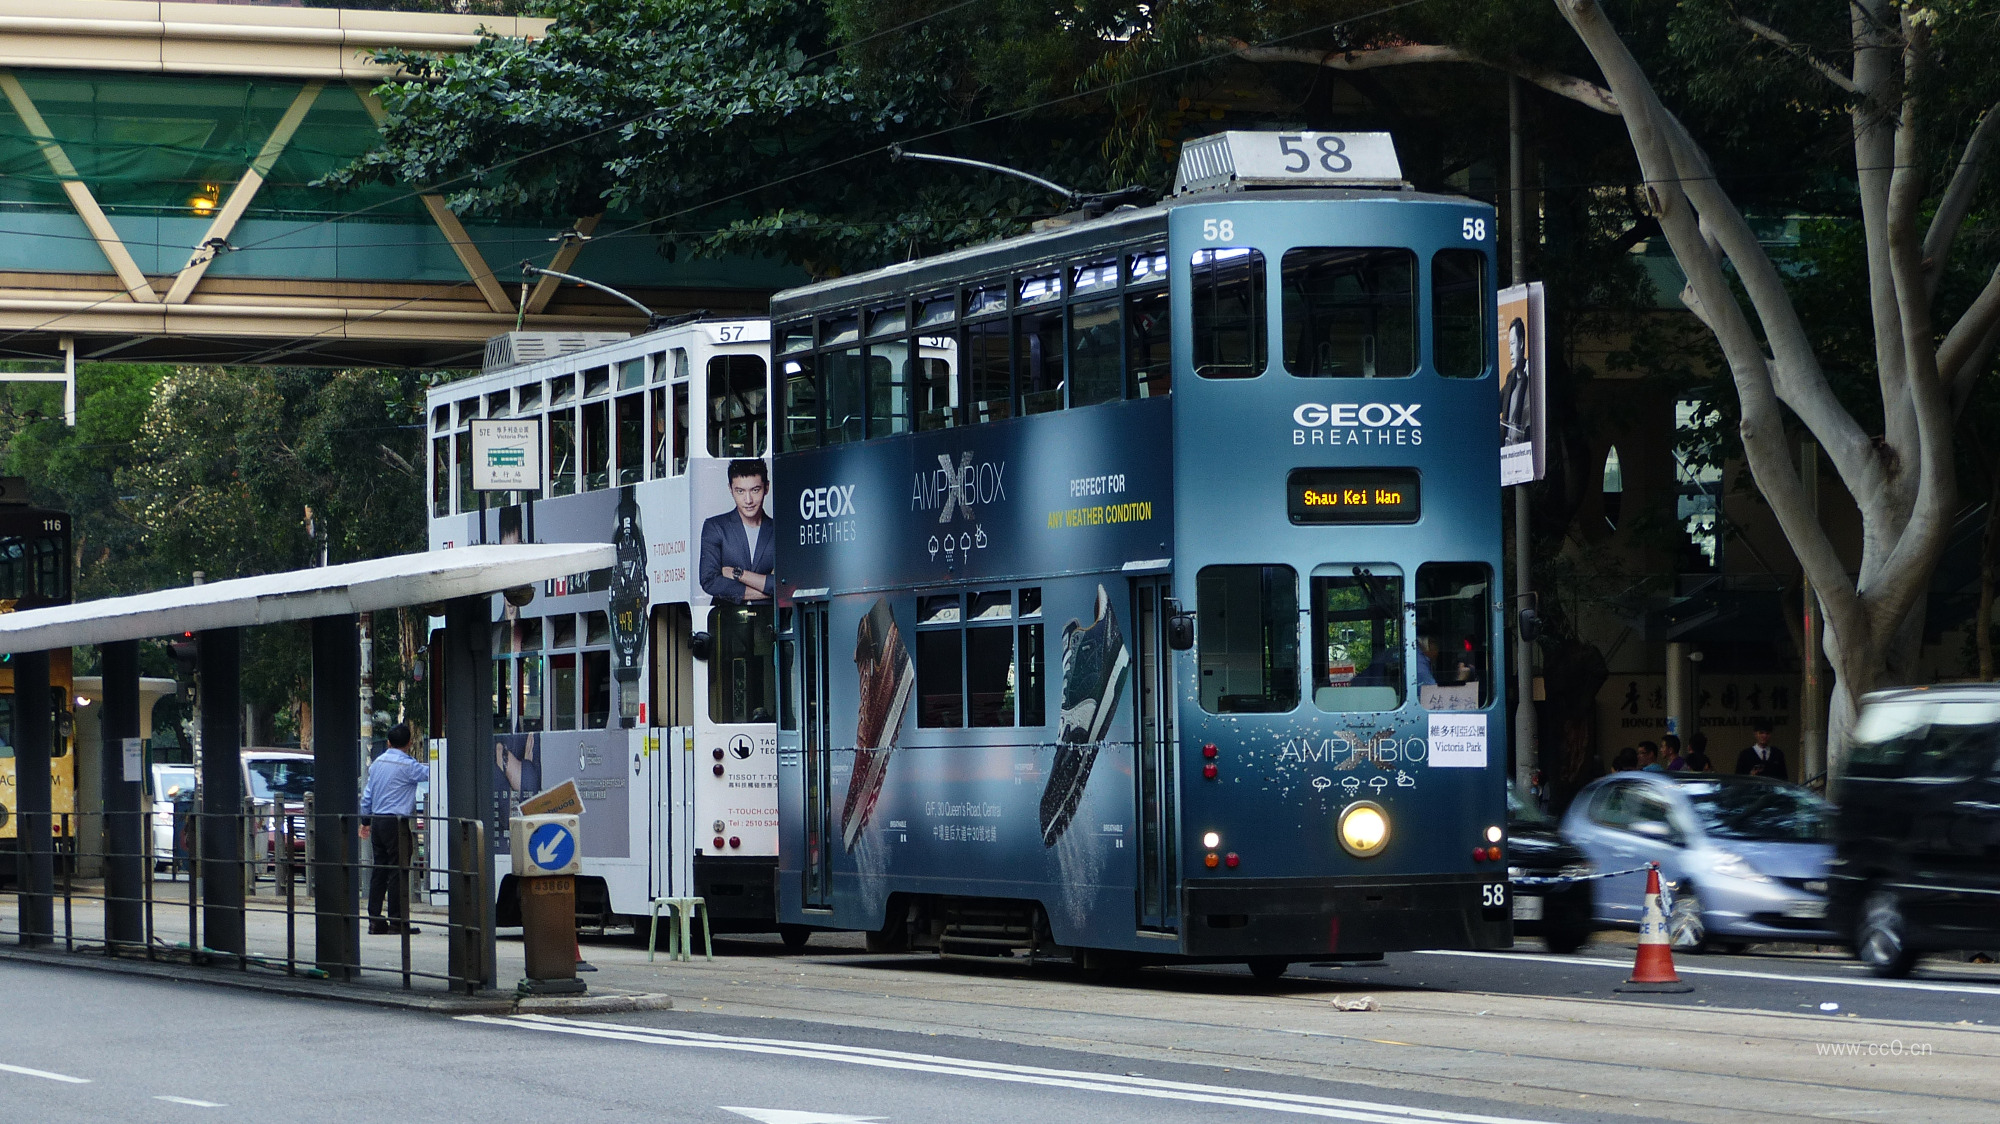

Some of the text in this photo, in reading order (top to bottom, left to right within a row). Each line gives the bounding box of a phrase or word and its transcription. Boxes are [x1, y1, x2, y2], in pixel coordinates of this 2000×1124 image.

[1278, 136, 1352, 173] 58
[1203, 219, 1234, 241] 58
[1462, 217, 1486, 241] 58
[719, 326, 745, 341] 57
[1293, 403, 1422, 427] GEOX
[479, 428, 491, 437] 57E
[1293, 429, 1422, 445] BREATHES
[911, 456, 1006, 516] AMPHIBIOX
[1070, 474, 1126, 497] PERFECT FOR
[800, 484, 856, 520] GEOX
[1304, 490, 1401, 505] Shau Kei Wan
[1047, 501, 1152, 529] ANY WEATHER CONDITION
[43, 519, 62, 531] 116
[800, 520, 857, 545] BREATHES
[653, 540, 686, 557] T-TOUCH.COM
[664, 569, 675, 583] 2510
[1621, 717, 1653, 728] HONG
[1699, 716, 1740, 727] ENTRAL
[1430, 725, 1486, 737] 維多利亞公園
[760, 747, 777, 755] TEC
[1280, 737, 1428, 763] AMPHIBIO
[1435, 741, 1482, 752] Victoria Park
[945, 801, 966, 817] Queen's
[966, 801, 982, 818] Road,
[982, 801, 1002, 817] Central
[1482, 883, 1505, 907] 58
